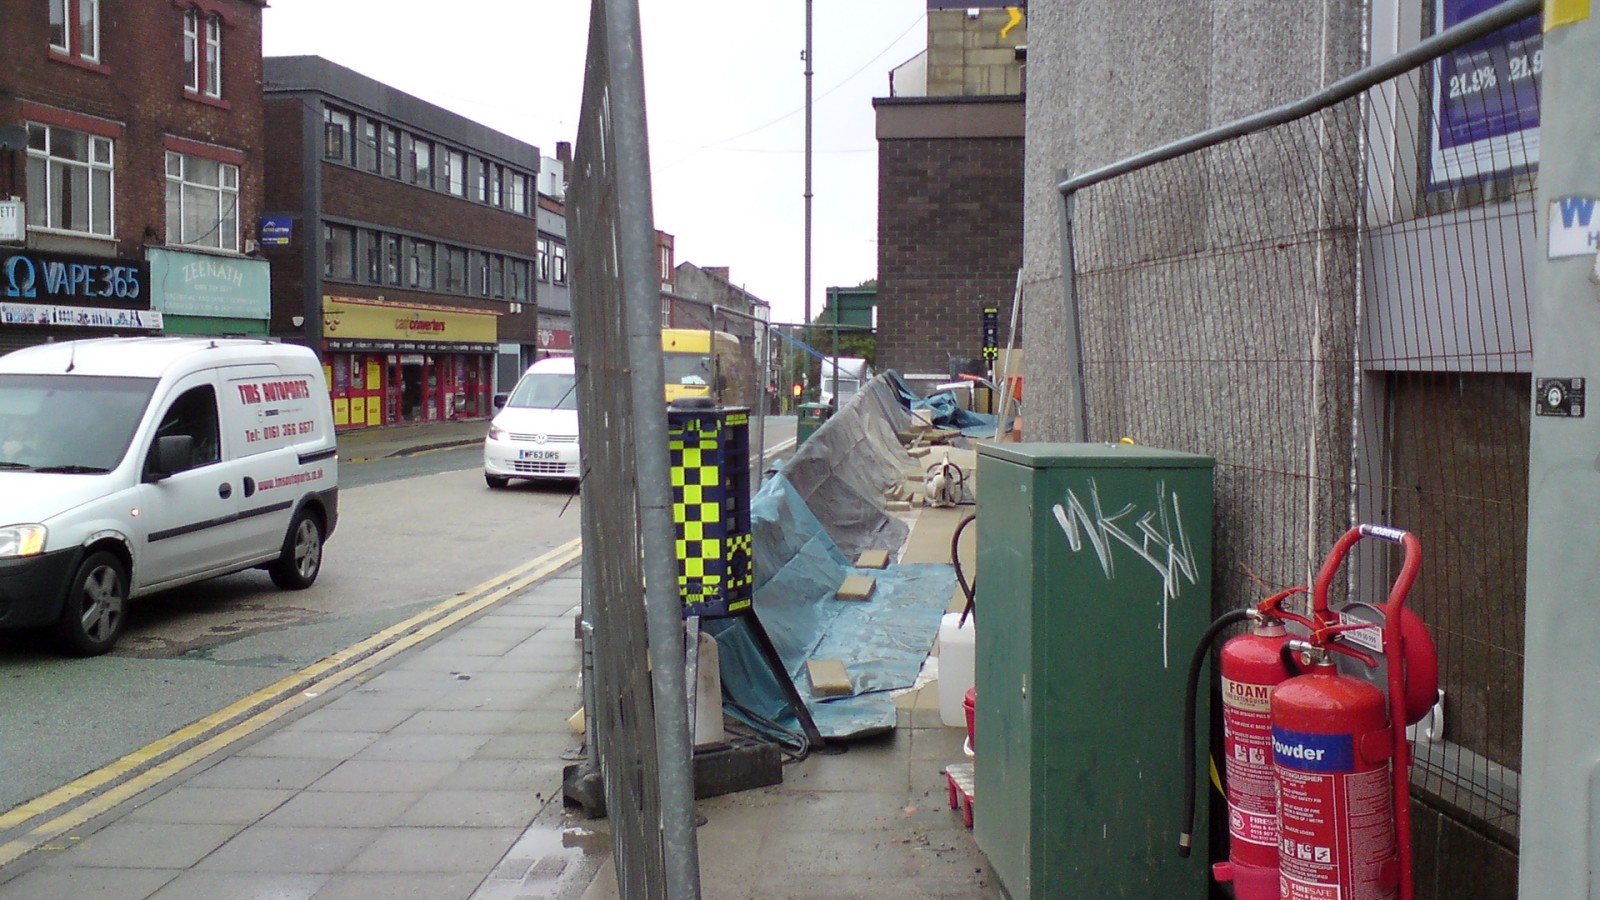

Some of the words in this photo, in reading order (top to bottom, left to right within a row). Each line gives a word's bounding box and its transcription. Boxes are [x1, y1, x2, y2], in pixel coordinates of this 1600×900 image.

[1449, 66, 1497, 99] 21.9%
[182, 260, 244, 287] ZEENATH
[262, 380, 310, 403] AUTOPARTS
[245, 428, 261, 443] Tel:
[264, 425, 280, 440] 0161
[1229, 682, 1268, 699] FOAM
[1291, 883, 1334, 896] FIRESAFE
